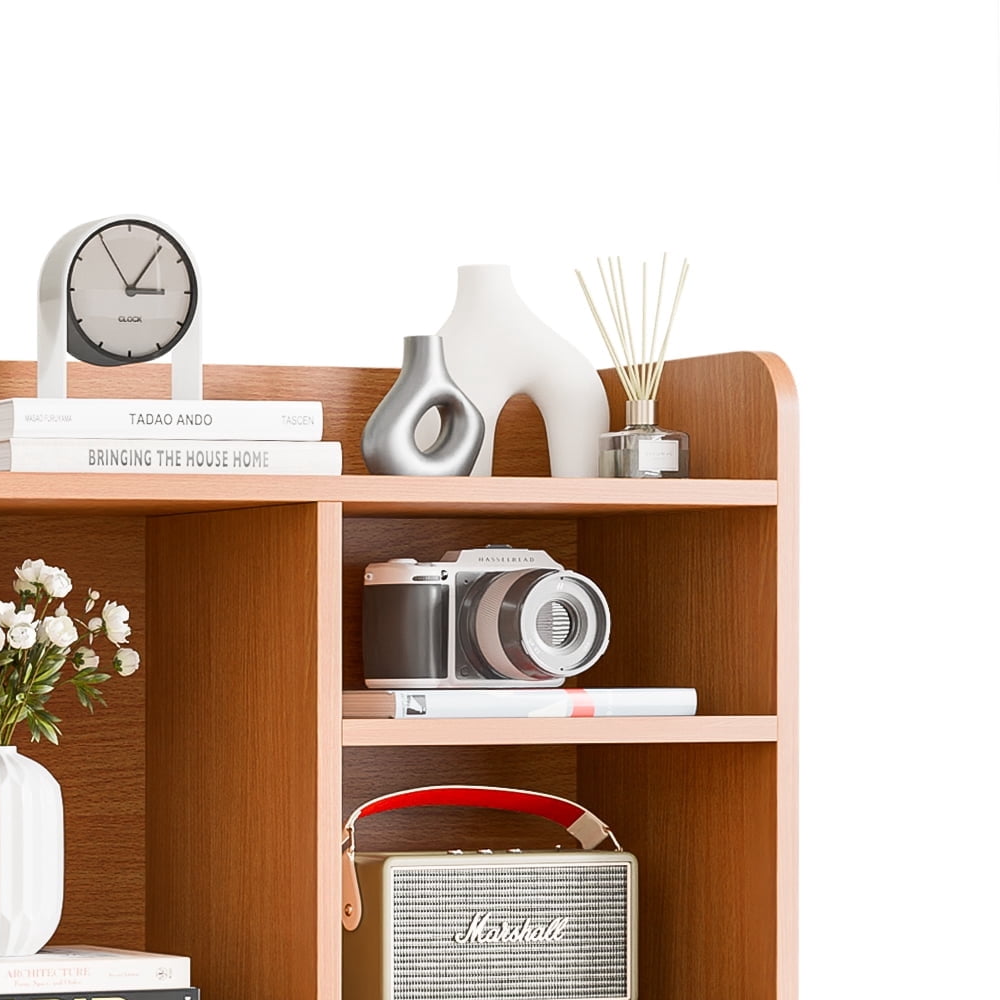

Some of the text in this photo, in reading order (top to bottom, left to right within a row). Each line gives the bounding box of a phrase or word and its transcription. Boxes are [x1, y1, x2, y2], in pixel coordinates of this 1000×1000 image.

[117, 315, 143, 323] CLOCK
[128, 412, 213, 426] TADAO ANDO
[88, 449, 270, 468] BRINGING THE HOUSE HOME
[454, 911, 569, 944] Marshall
[7, 967, 90, 978] ARCHITECTURE
